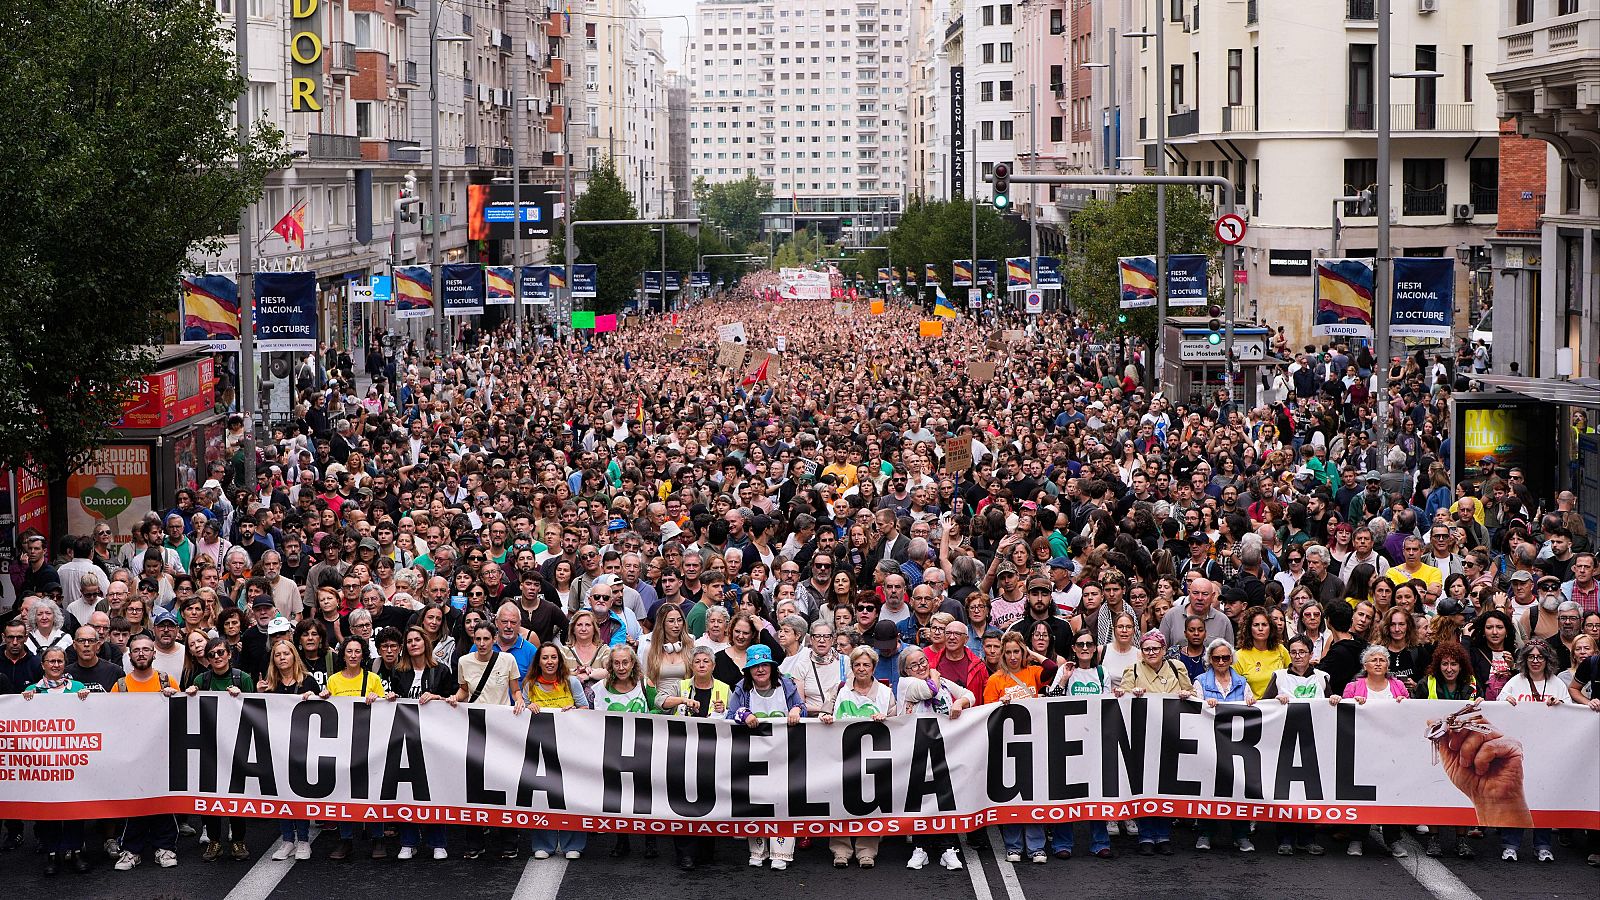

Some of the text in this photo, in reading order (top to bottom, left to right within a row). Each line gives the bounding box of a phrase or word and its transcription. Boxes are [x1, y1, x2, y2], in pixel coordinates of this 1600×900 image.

[372, 277, 379, 287] P
[1397, 281, 1422, 290] FIESTA
[261, 296, 286, 304] FIESTA
[1397, 292, 1438, 300] NACIONAL
[261, 306, 303, 314] NACIONAL
[1405, 311, 1444, 321] OCTUBRE
[262, 325, 310, 335] 12 OCTUBRE
[1331, 327, 1358, 335] MADRID
[84, 496, 127, 505] Danacol
[0, 718, 76, 733] SINDICATO
[0, 735, 99, 751] DE INQUILINAS
[9, 753, 89, 768] INQUILINOS
[168, 695, 1377, 818] HACIA LA HUELGA GENERAL
[0, 768, 75, 781] DE MADRID
[195, 799, 294, 816] BAJADA
[306, 804, 352, 819] DEL
[364, 806, 489, 823] ALQUILER
[501, 813, 549, 827] 50%
[582, 817, 779, 834] EXPROPIACIÓN
[793, 819, 900, 834] FONDOS
[913, 809, 998, 832] BUITRE
[1031, 800, 1178, 820] CONTRATOS
[1187, 802, 1359, 821] INDEFINIDOS
